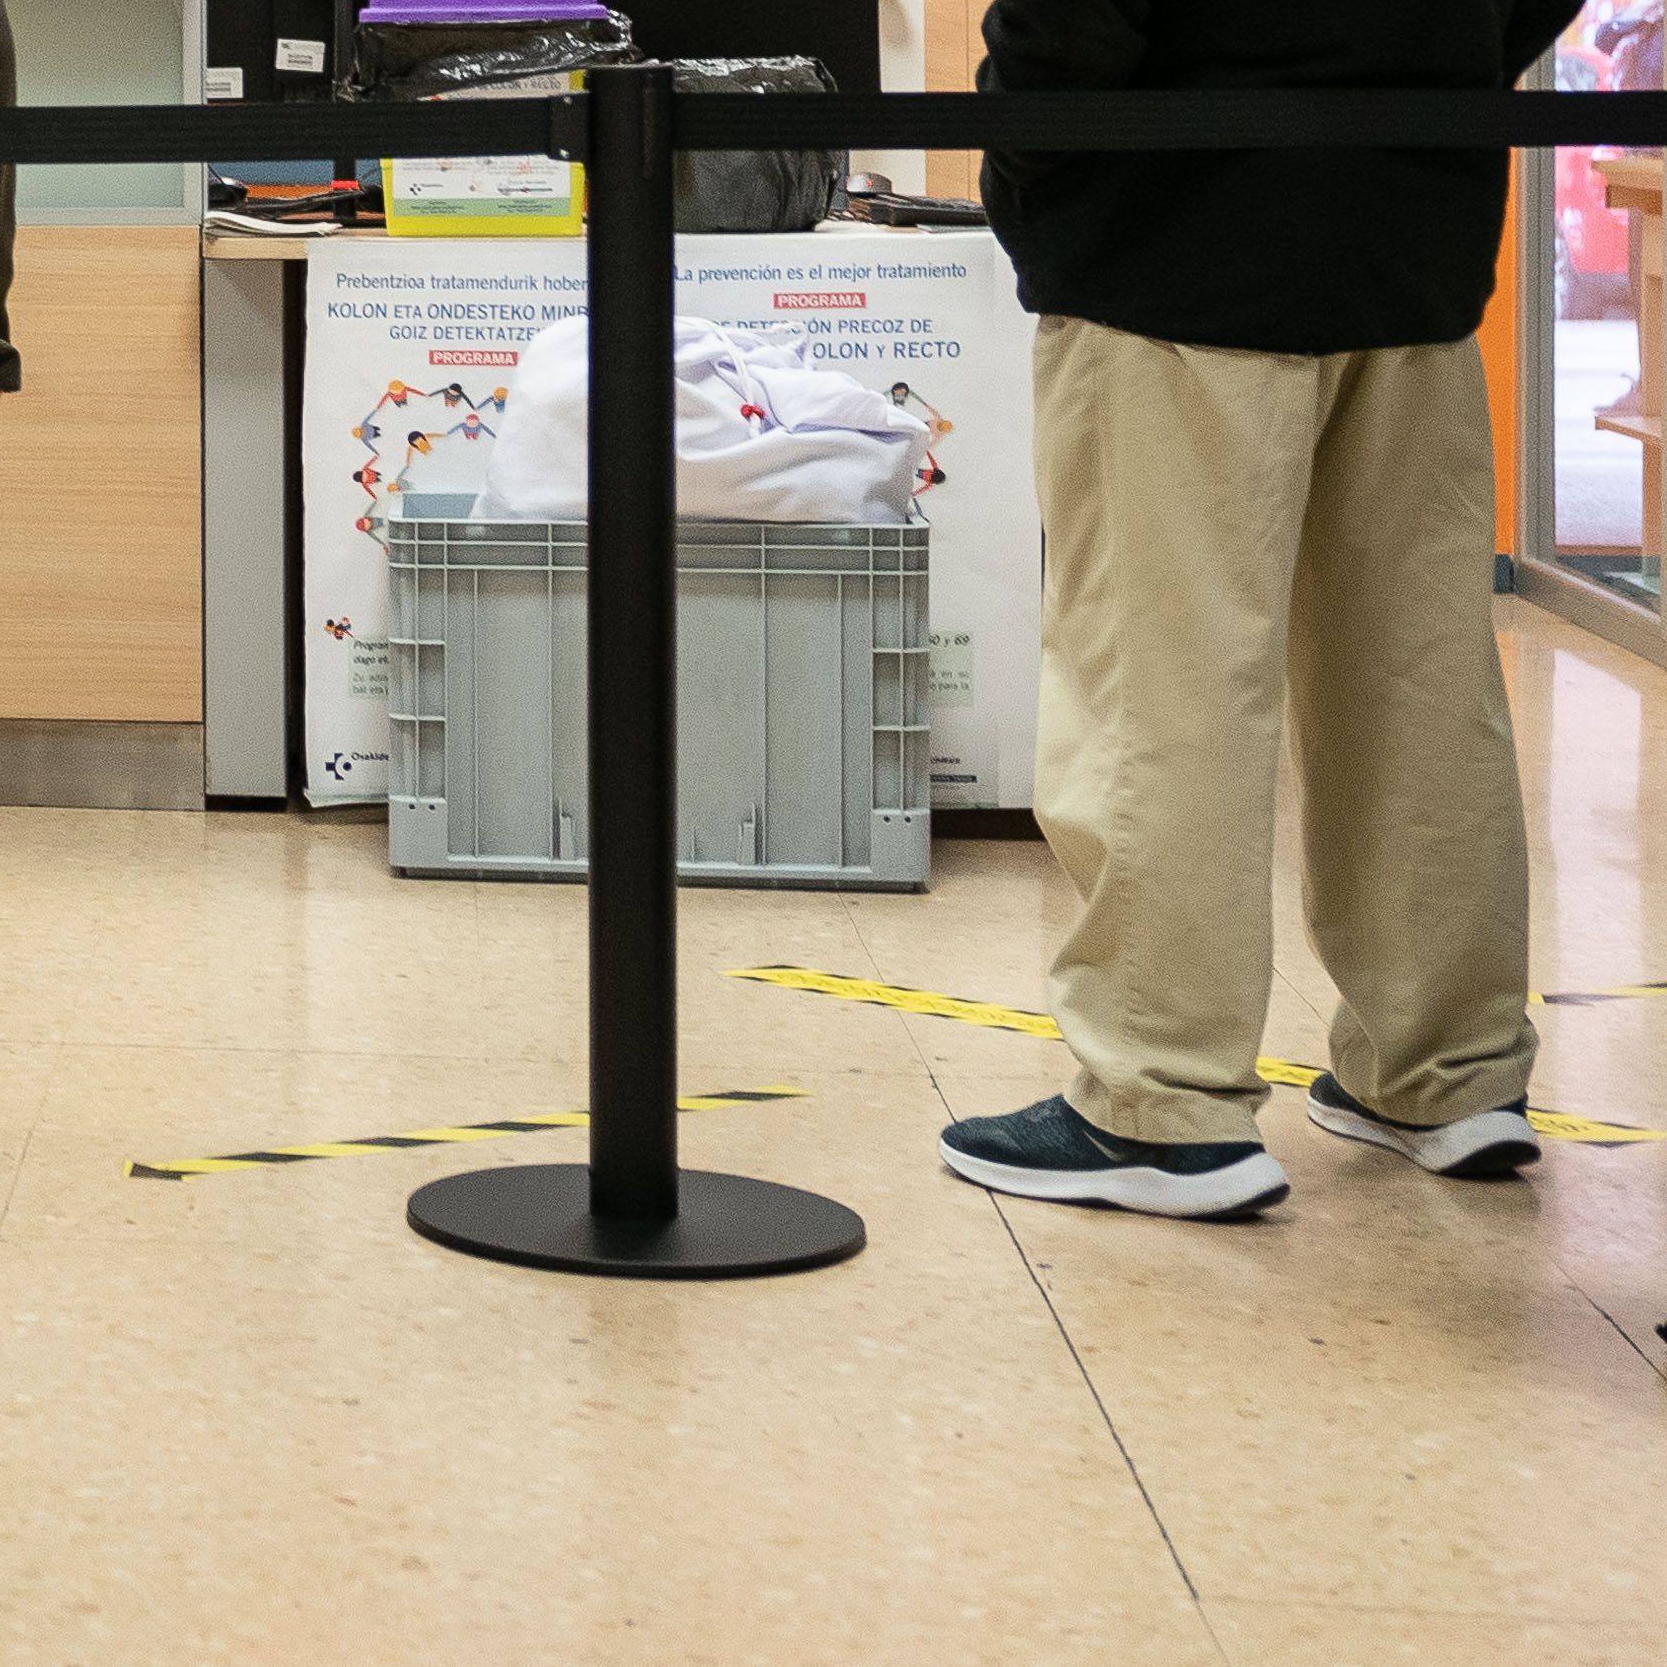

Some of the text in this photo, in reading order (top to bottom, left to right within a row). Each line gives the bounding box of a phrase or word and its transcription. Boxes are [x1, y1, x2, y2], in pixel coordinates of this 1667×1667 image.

[336, 272, 588, 291] Prebentzioa tratamendurik hober
[675, 262, 967, 284] La prevención es el mejor tratamiento
[778, 294, 862, 308] PROGRAMA
[327, 302, 535, 320] KOLON ETA ONDESTEKO
[389, 325, 540, 342] GOIZ DETEKTATZE
[838, 319, 934, 334] PRECOZ DE
[434, 351, 516, 365] PROGRAMA
[813, 341, 867, 359] OLON
[894, 341, 961, 359] RECTO
[351, 752, 389, 761] Osakide
